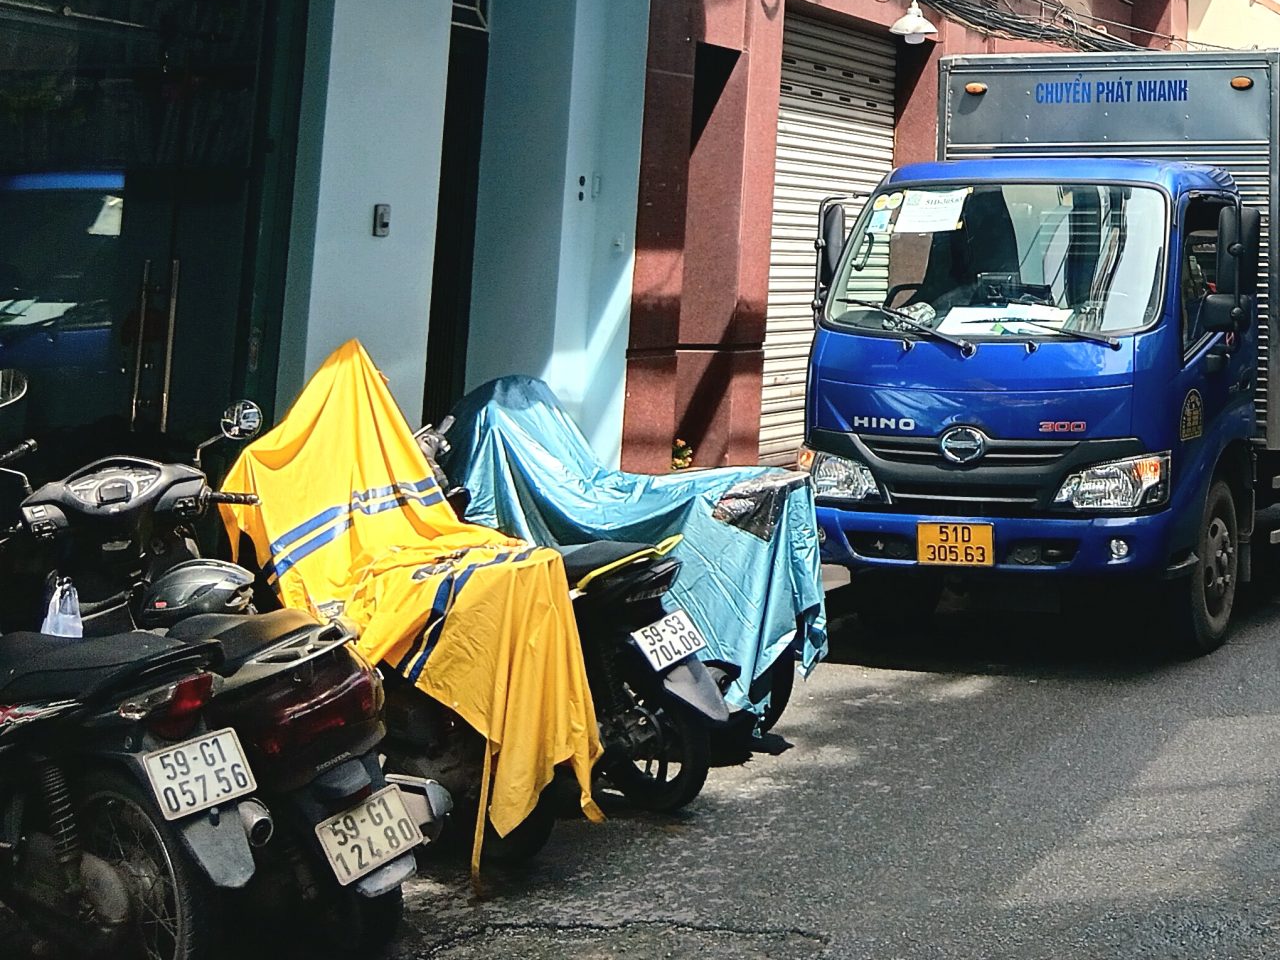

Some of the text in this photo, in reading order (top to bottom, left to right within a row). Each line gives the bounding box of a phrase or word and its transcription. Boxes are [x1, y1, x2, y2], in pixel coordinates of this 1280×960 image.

[1035, 73, 1188, 103] CHUYỂN PHÁT NHANH
[853, 416, 915, 431] HINO
[1038, 421, 1087, 433] 300
[939, 525, 972, 543] 51D
[926, 544, 986, 563] 305.63
[641, 615, 686, 646] 59-S3
[650, 631, 701, 667] 704.08
[159, 737, 227, 780] 59-G1
[315, 751, 352, 771] HONDA
[163, 763, 248, 813] 057.56
[328, 796, 395, 847] 59-G1
[335, 817, 415, 877] 124.80
